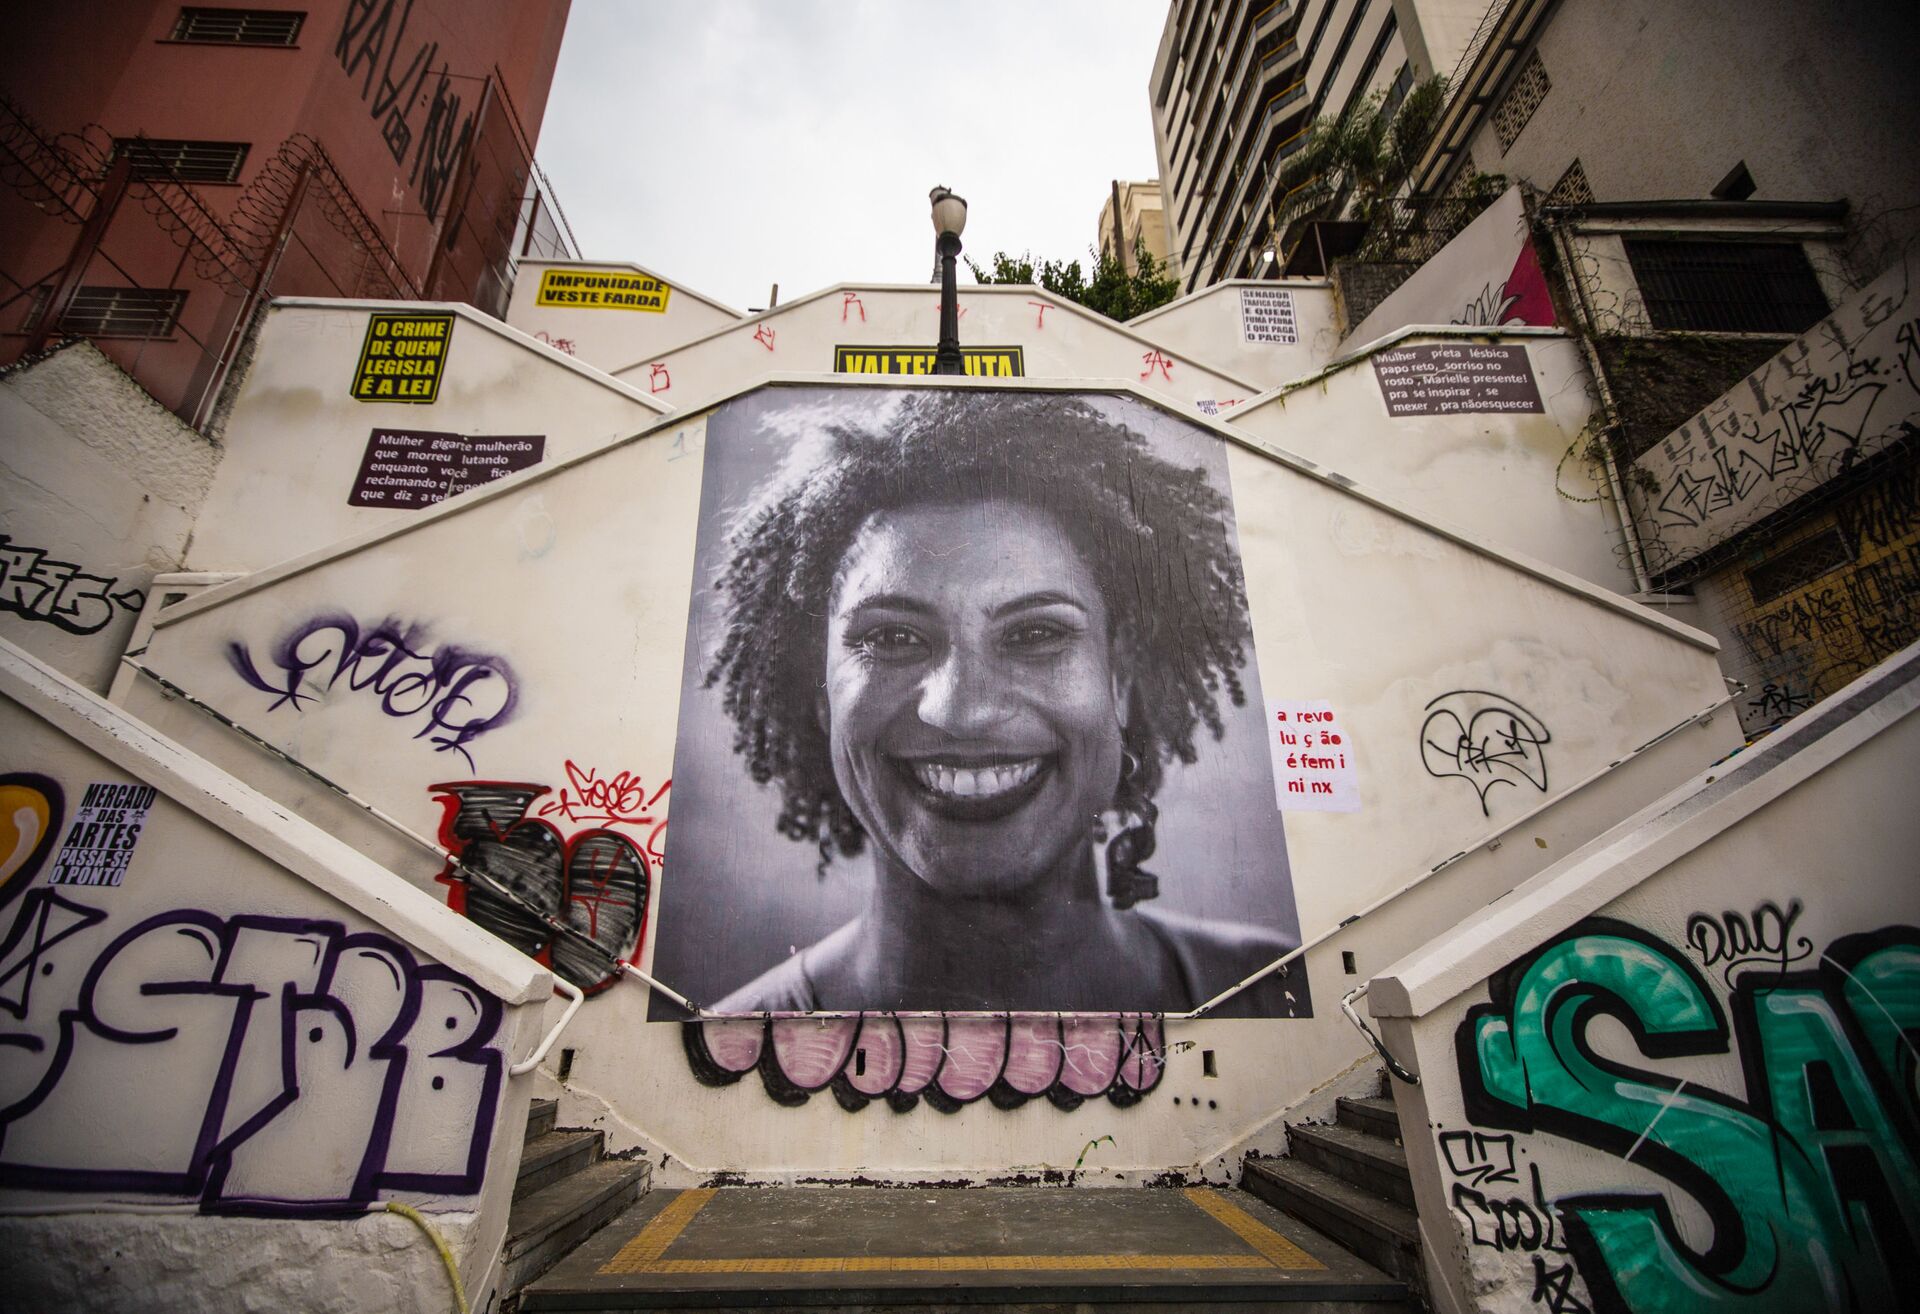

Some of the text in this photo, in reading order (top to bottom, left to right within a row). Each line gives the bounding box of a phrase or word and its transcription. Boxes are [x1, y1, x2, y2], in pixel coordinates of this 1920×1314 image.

[549, 275, 663, 292] IMPUNIDADE
[545, 290, 661, 307] VESTE FARDA
[1243, 290, 1289, 299] SENADOR
[1244, 299, 1291, 308] TRAFICA COCA
[1255, 308, 1291, 316] QUEM
[1246, 316, 1293, 325] FUMA PEDRA
[375, 321, 446, 337] O CRIME
[1253, 325, 1269, 333] QUE
[1271, 326, 1294, 334] PAGA
[1248, 333, 1296, 343] O PACTO
[370, 340, 441, 358] DE QUEM
[1376, 348, 1509, 363] Mulher preta lésbica
[364, 359, 435, 376] LEGISLA
[1380, 361, 1502, 376] papo reto, sorriso no
[359, 376, 432, 395] É A LEI
[1385, 376, 1414, 386] rosto
[1423, 374, 1470, 385] Marielle
[1473, 373, 1527, 384] presente!
[1389, 391, 1408, 400] pra
[1413, 389, 1426, 397] se
[1428, 387, 1470, 398] inspirar
[1485, 387, 1499, 395] se
[1393, 403, 1428, 412] mexer
[1441, 400, 1460, 410] pra
[379, 435, 425, 447] Mulher
[475, 440, 532, 451] mulherão
[375, 450, 509, 464] que morreu lutando
[370, 462, 429, 475] enquanto
[441, 467, 468, 478] você
[365, 475, 437, 489] reclamando
[439, 480, 448, 489] e
[360, 489, 385, 500] que
[394, 490, 412, 501] diz
[421, 493, 429, 502] a
[1278, 711, 1334, 723] a revo
[1280, 730, 1297, 745] lu
[1321, 731, 1342, 745] ão
[1287, 753, 1297, 768] é
[1301, 753, 1335, 769] fem
[1288, 778, 1333, 794] ni nx
[81, 783, 158, 810] MERCADO
[96, 809, 127, 823] DAS
[63, 822, 142, 850] ARTES
[57, 849, 132, 867] PASSA-SE
[50, 865, 125, 886] O PONTO
